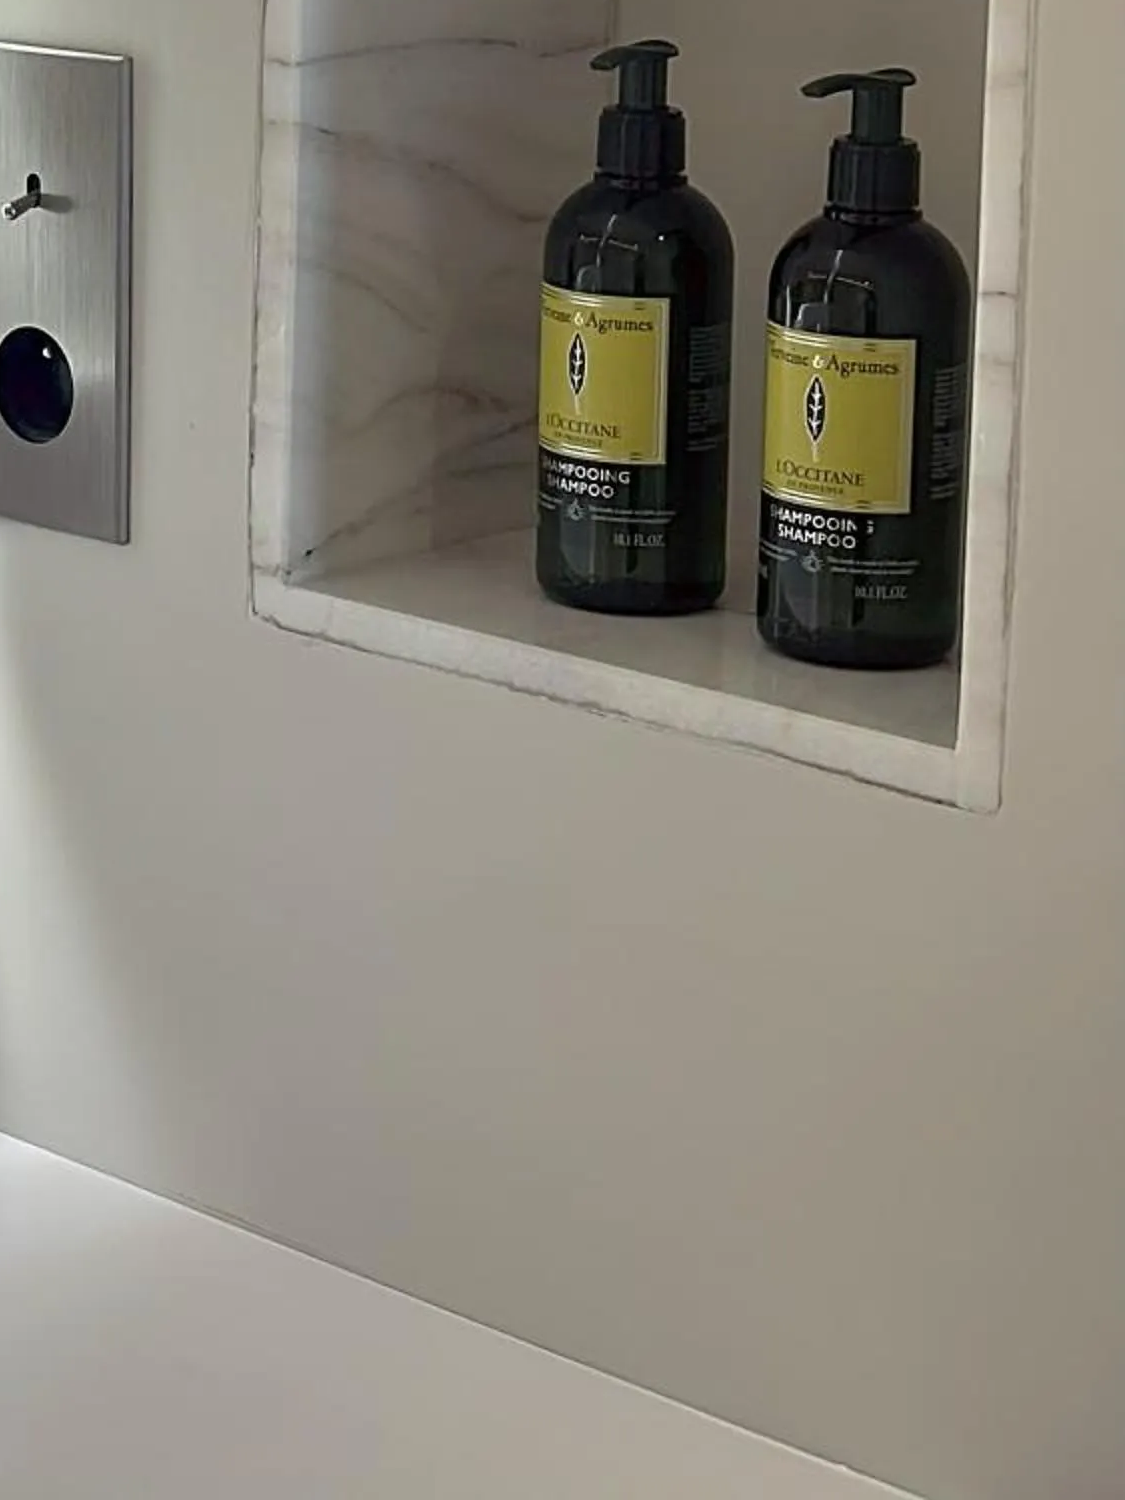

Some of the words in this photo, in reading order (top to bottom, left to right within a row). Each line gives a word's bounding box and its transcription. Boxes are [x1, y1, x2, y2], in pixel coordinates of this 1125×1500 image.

[585, 311, 654, 334] Agrumes
[825, 353, 901, 377] Agrumes
[777, 523, 857, 549] SHAMPOO
